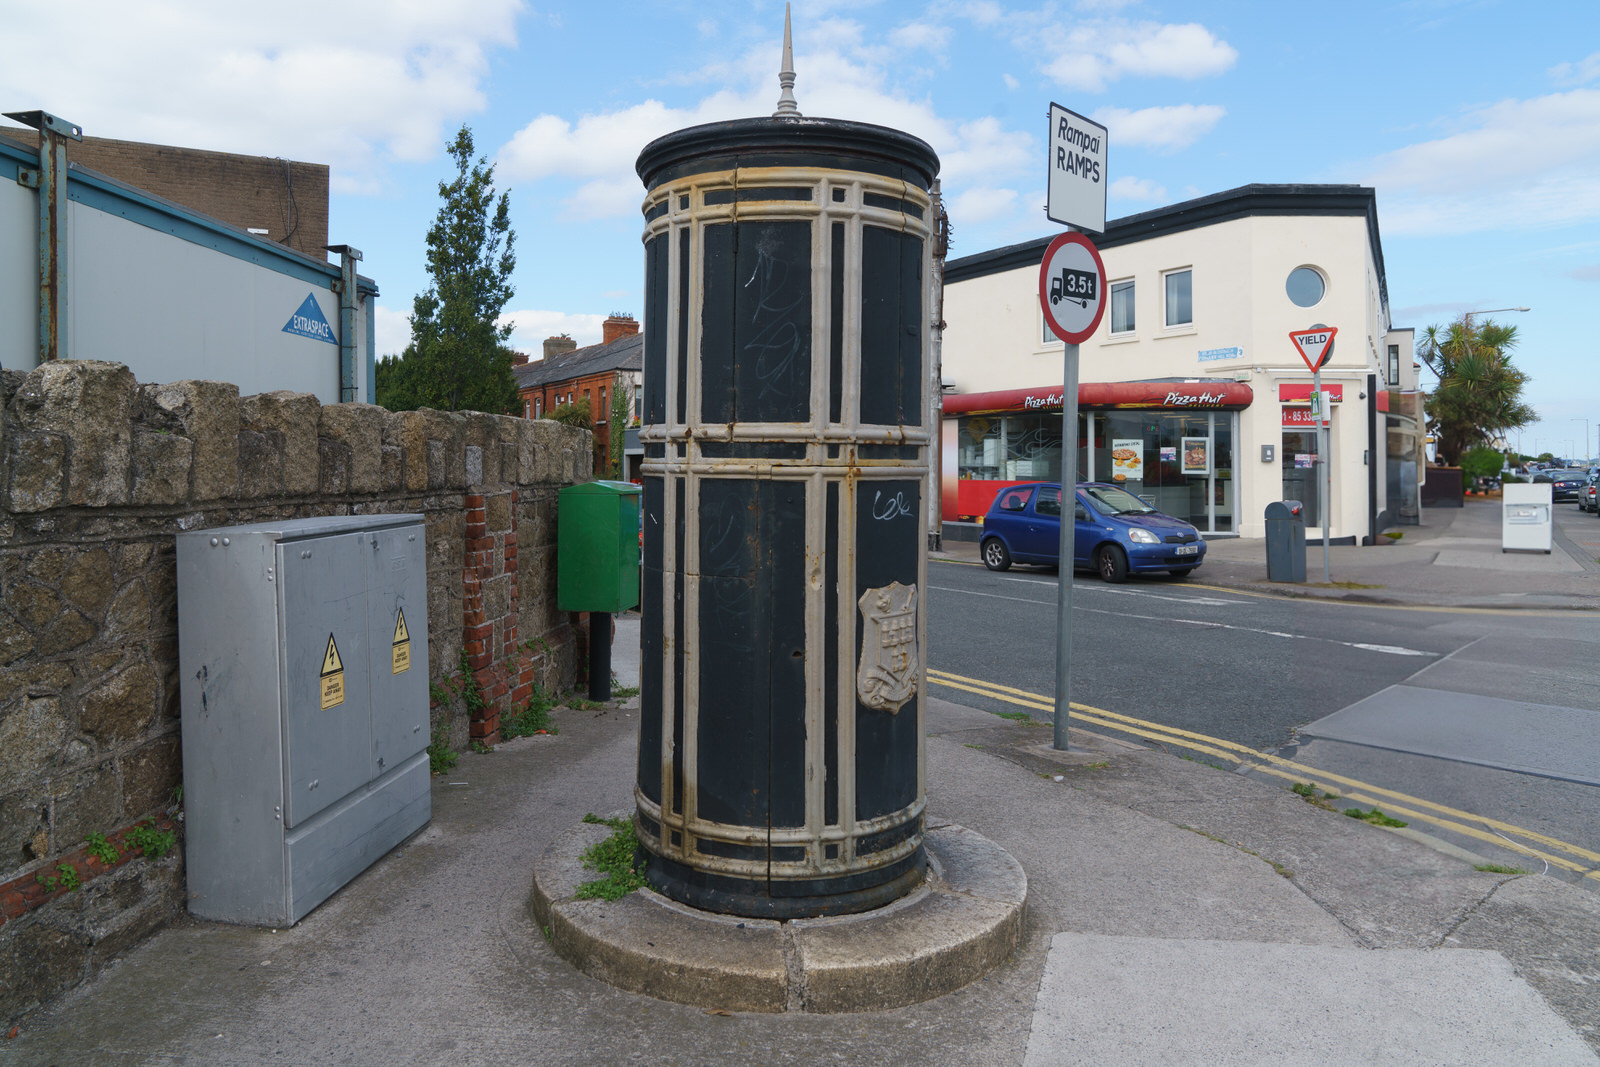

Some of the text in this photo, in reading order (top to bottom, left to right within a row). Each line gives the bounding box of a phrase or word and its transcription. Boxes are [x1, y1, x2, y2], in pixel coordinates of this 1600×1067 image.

[1057, 145, 1100, 183] RAMPS
[1067, 273, 1092, 294] 3.5t
[294, 315, 329, 337] EXTRASPACE
[1298, 334, 1327, 345] YIELD
[1024, 393, 1064, 409] Pizza Hut
[1162, 391, 1227, 405] Pizza Hut
[1292, 411, 1302, 422] 85
